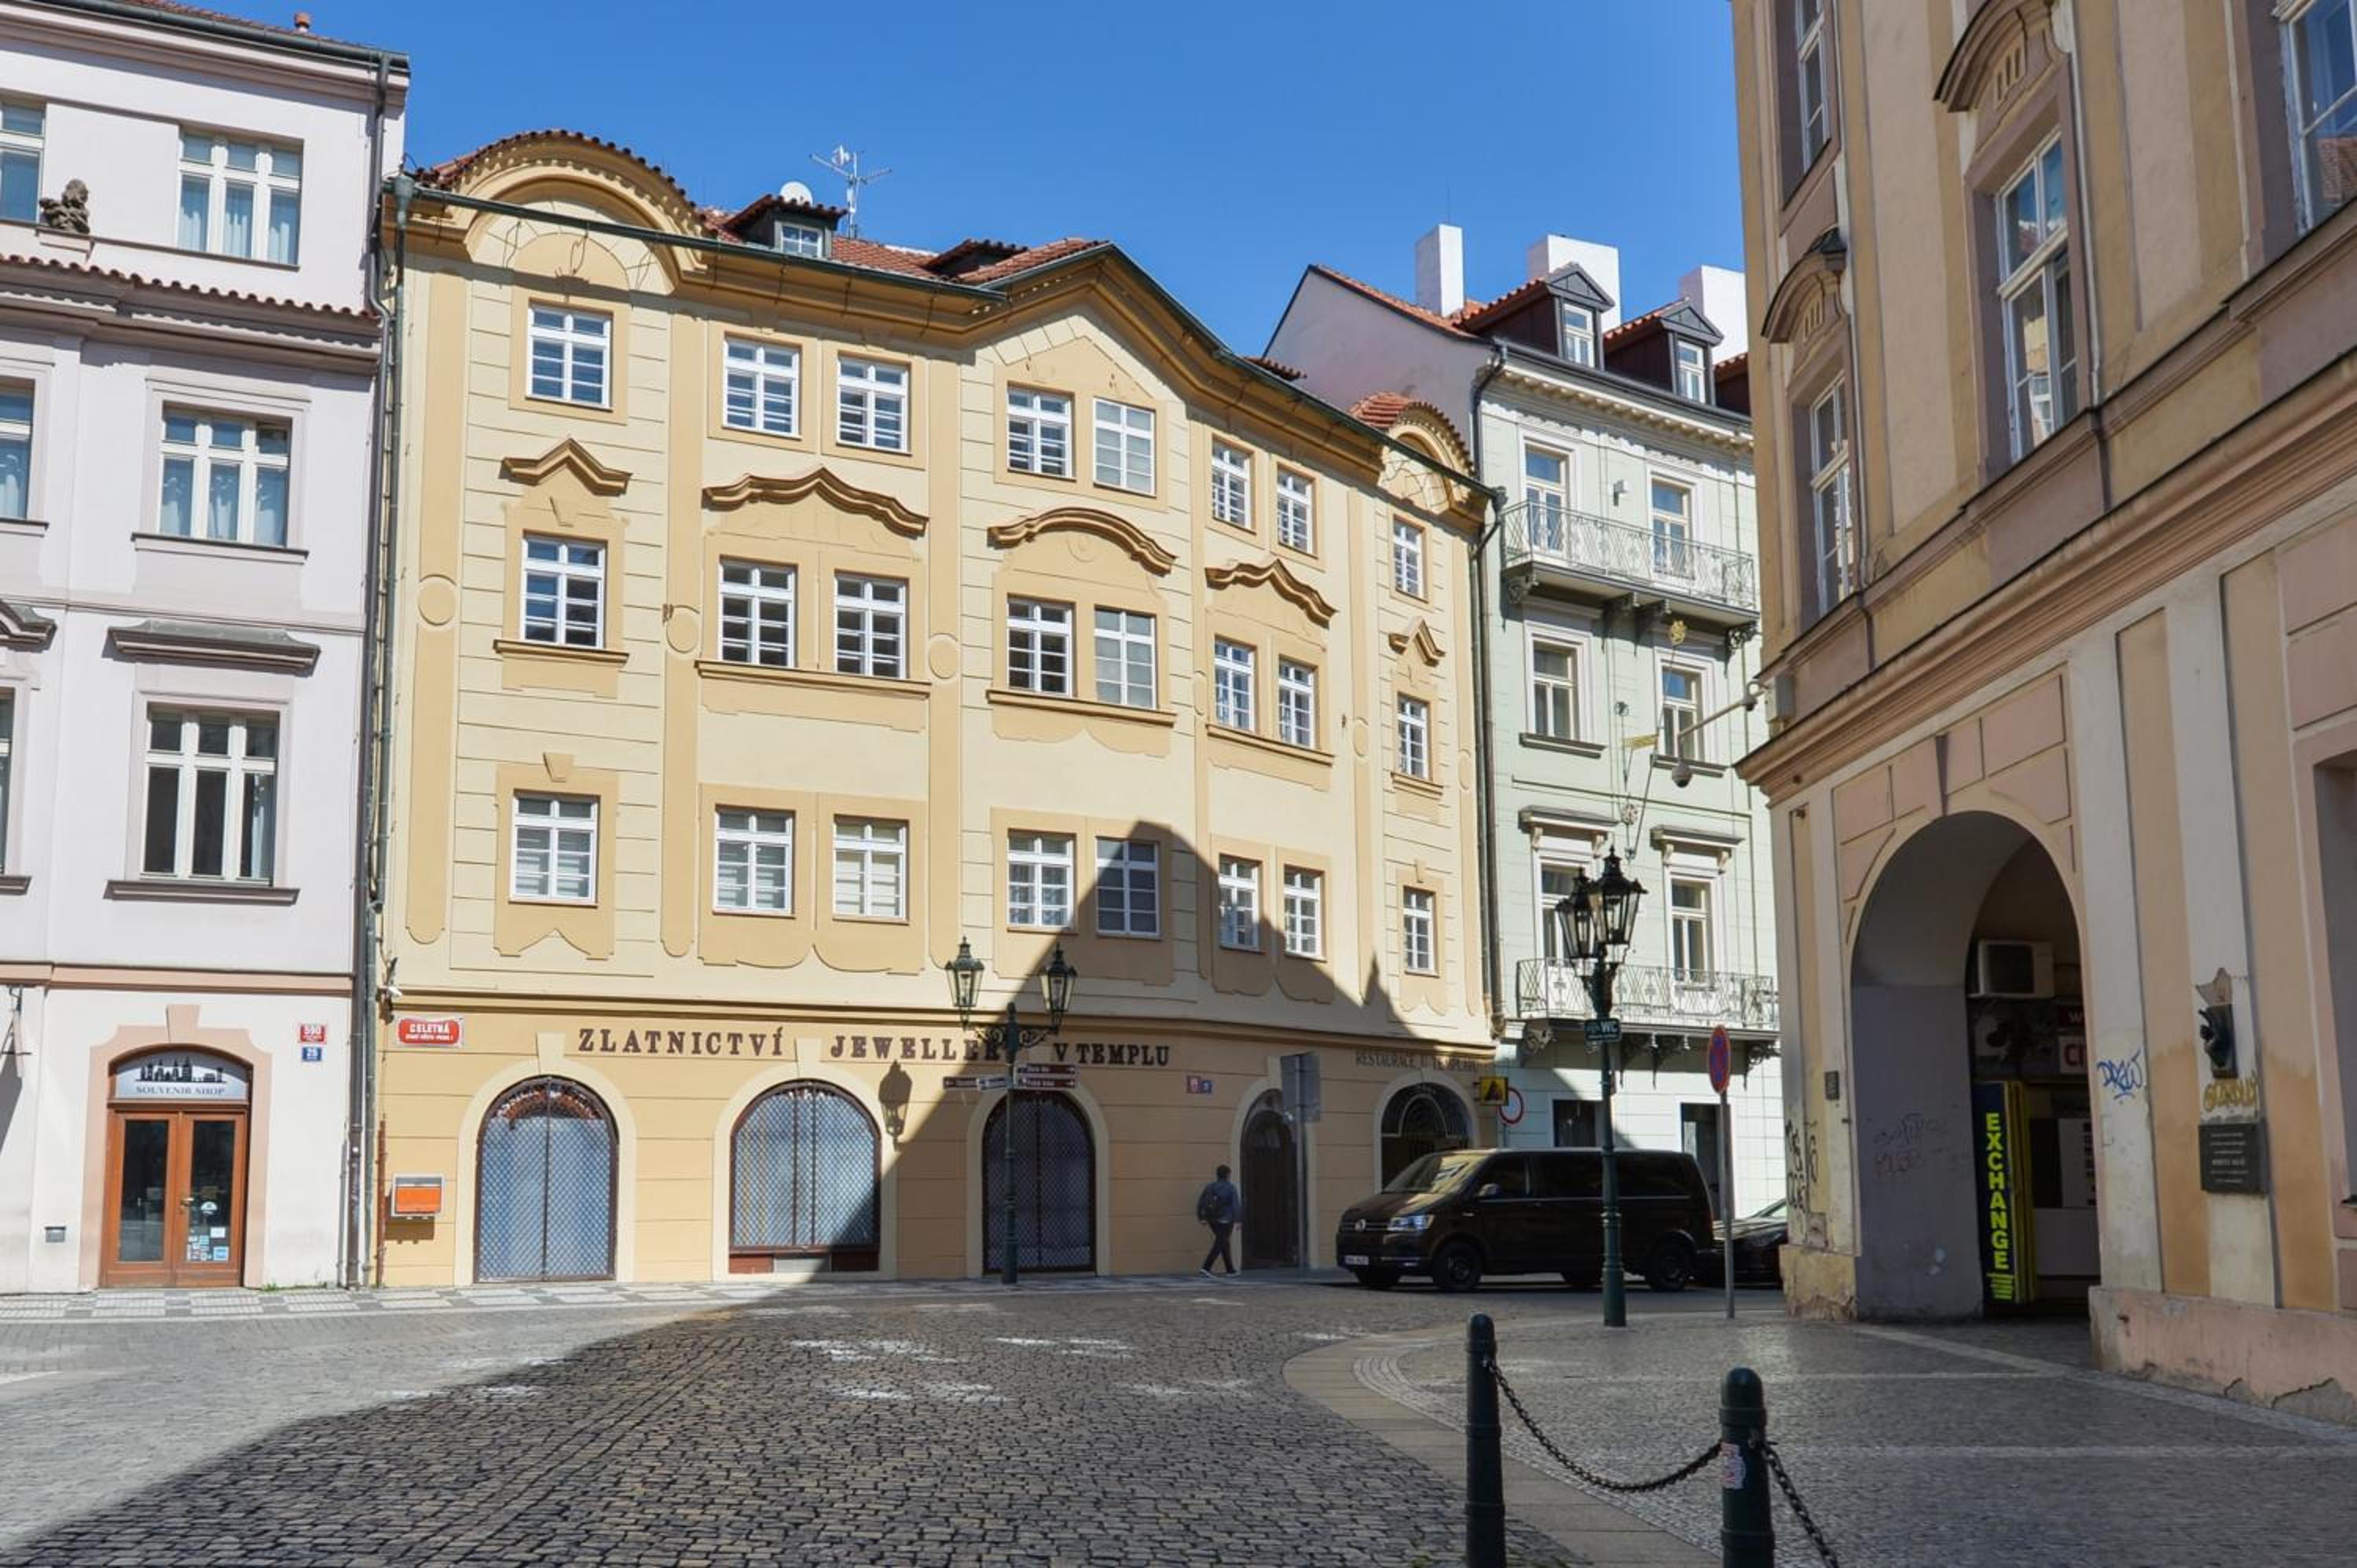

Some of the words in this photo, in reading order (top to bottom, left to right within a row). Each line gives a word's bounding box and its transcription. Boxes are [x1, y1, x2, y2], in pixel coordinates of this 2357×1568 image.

[578, 1026, 783, 1056] ZLATNICTVÍ
[830, 1035, 1017, 1061] JEWELLER
[1053, 1043, 1069, 1061] V
[1076, 1043, 1171, 1067] TEMPLU
[136, 1085, 192, 1095] SOUVENIR
[196, 1086, 226, 1096] SHOP
[1985, 1112, 2010, 1270] EXCHANGE
